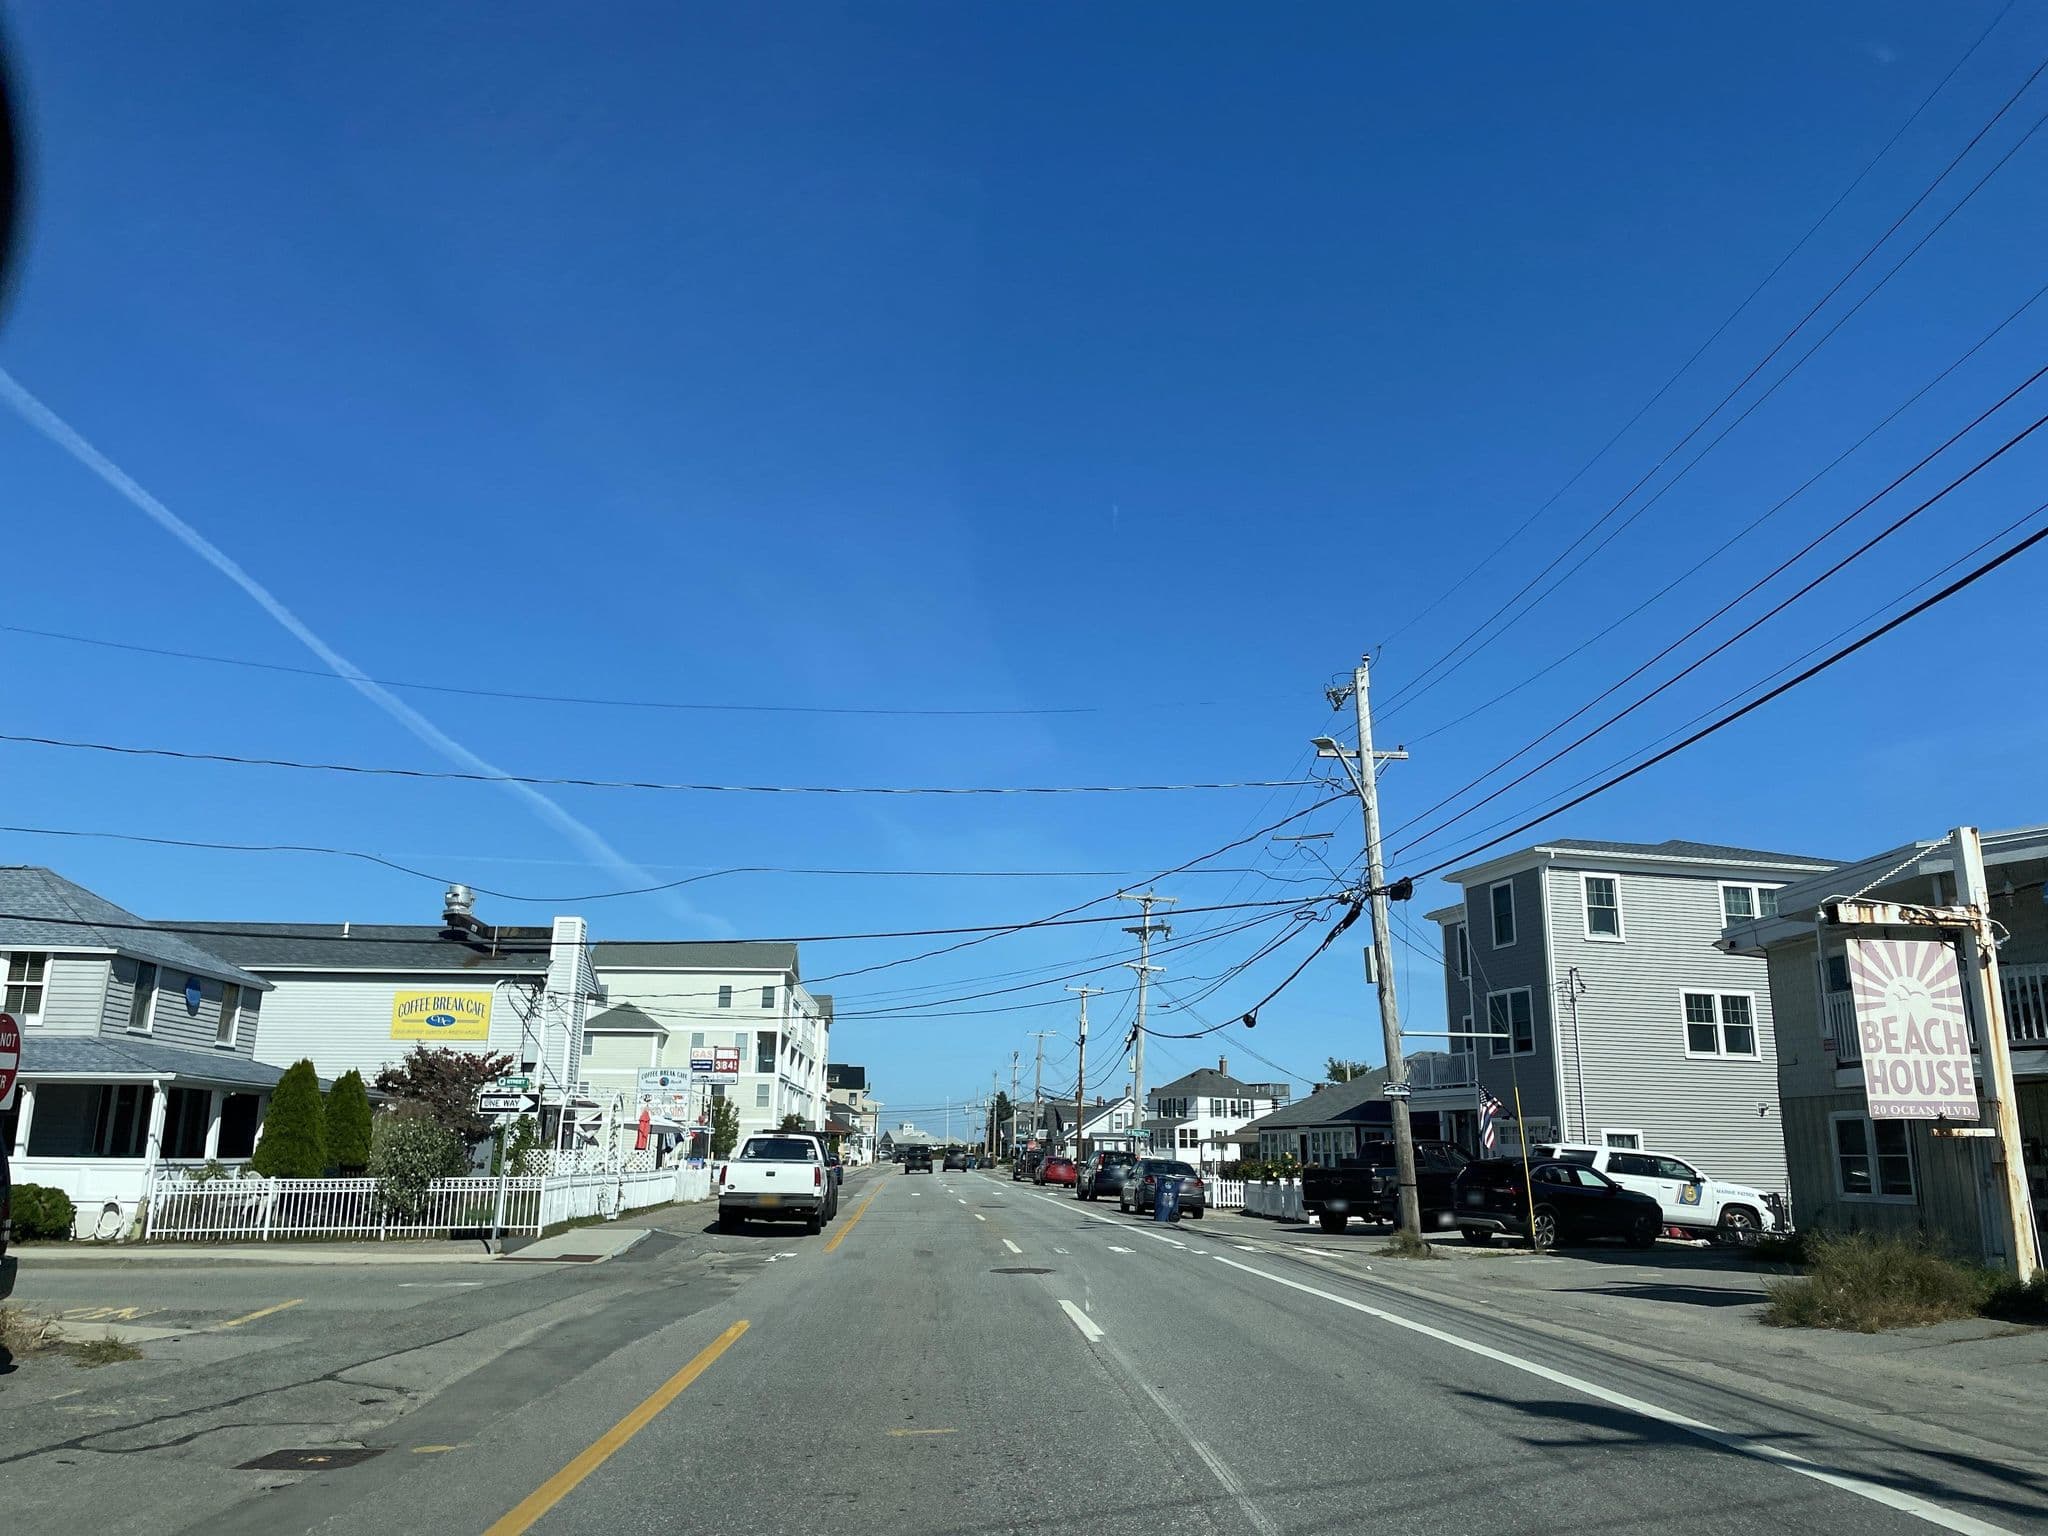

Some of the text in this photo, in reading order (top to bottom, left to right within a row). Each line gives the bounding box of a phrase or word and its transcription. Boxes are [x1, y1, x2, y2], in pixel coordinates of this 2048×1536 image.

[398, 996, 487, 1019] COFFEE BREAK CAFE
[1860, 1012, 1968, 1055] BEACH
[692, 1050, 713, 1058] GAS
[641, 1069, 688, 1080] COFFEE BREAK CAFE
[1865, 1059, 1975, 1096] HOUSE
[484, 1099, 520, 1107] ONE WAY
[1873, 1104, 1976, 1116] 20 OCEAN BLVD.
